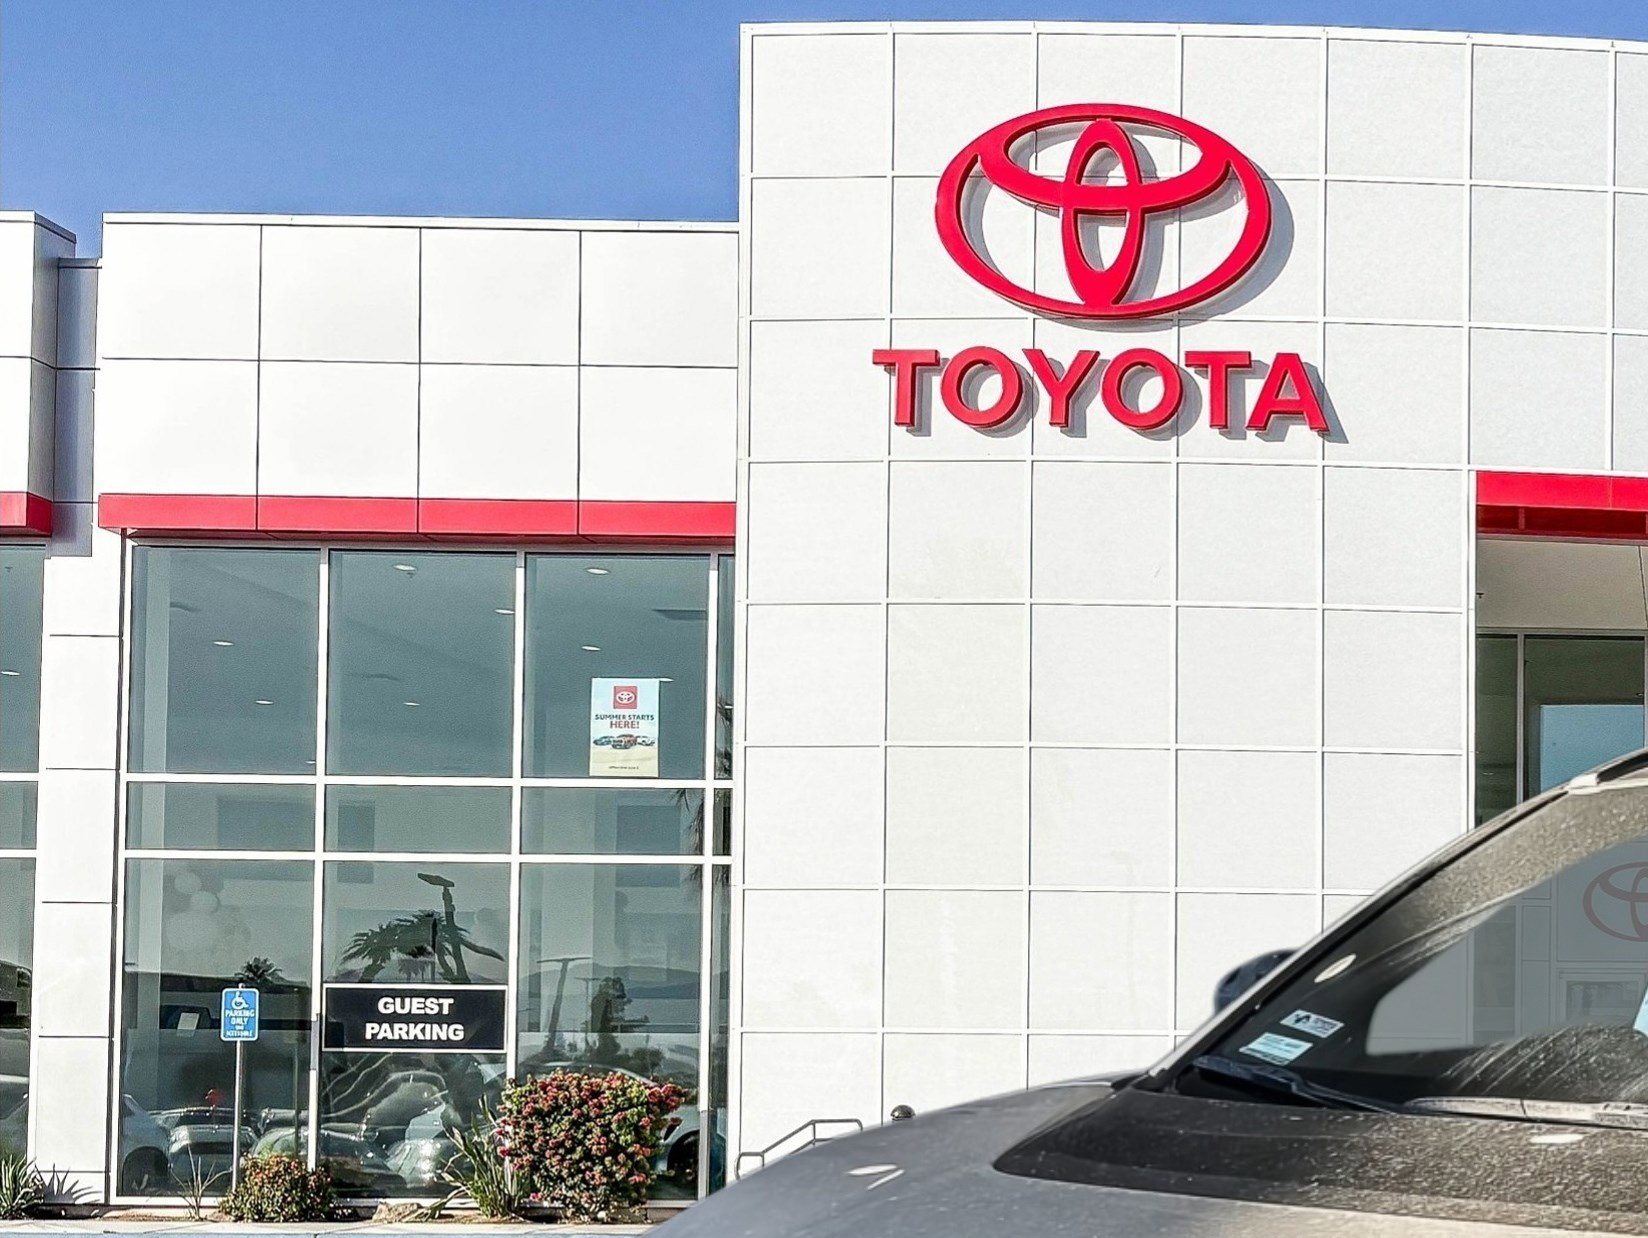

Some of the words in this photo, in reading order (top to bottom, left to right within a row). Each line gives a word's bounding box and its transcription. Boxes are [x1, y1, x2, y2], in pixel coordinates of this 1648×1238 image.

[872, 346, 1330, 435] TOYOTA
[609, 720, 640, 729] HERE!
[377, 997, 454, 1015] GUEST
[365, 1022, 465, 1041] PARKING
